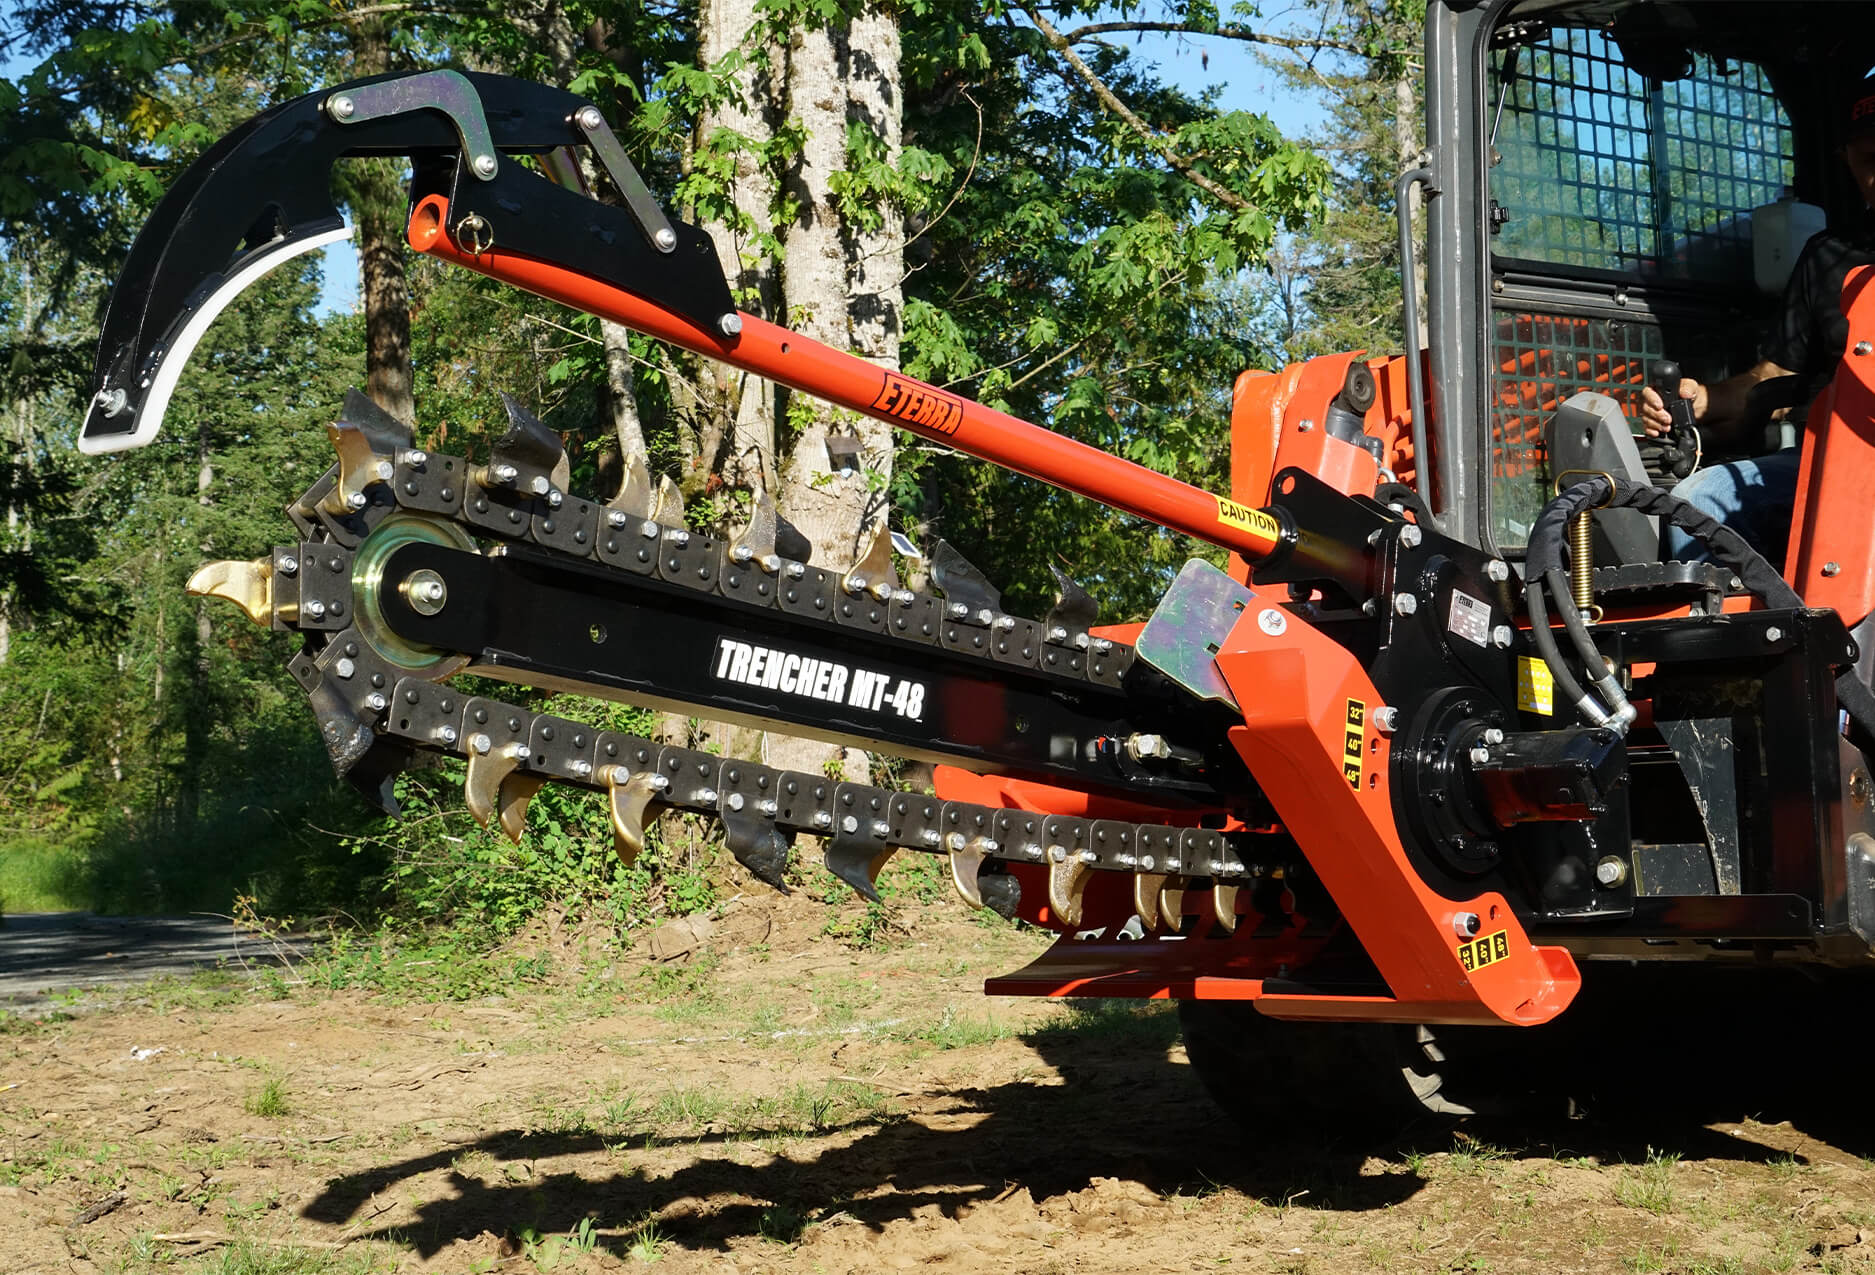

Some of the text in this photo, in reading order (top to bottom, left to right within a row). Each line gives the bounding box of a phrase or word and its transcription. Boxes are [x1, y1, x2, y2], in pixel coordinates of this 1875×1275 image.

[873, 382, 962, 435] ETERRA
[1219, 500, 1276, 533] CAUTION
[716, 638, 925, 720] TRENCHER MT-48
